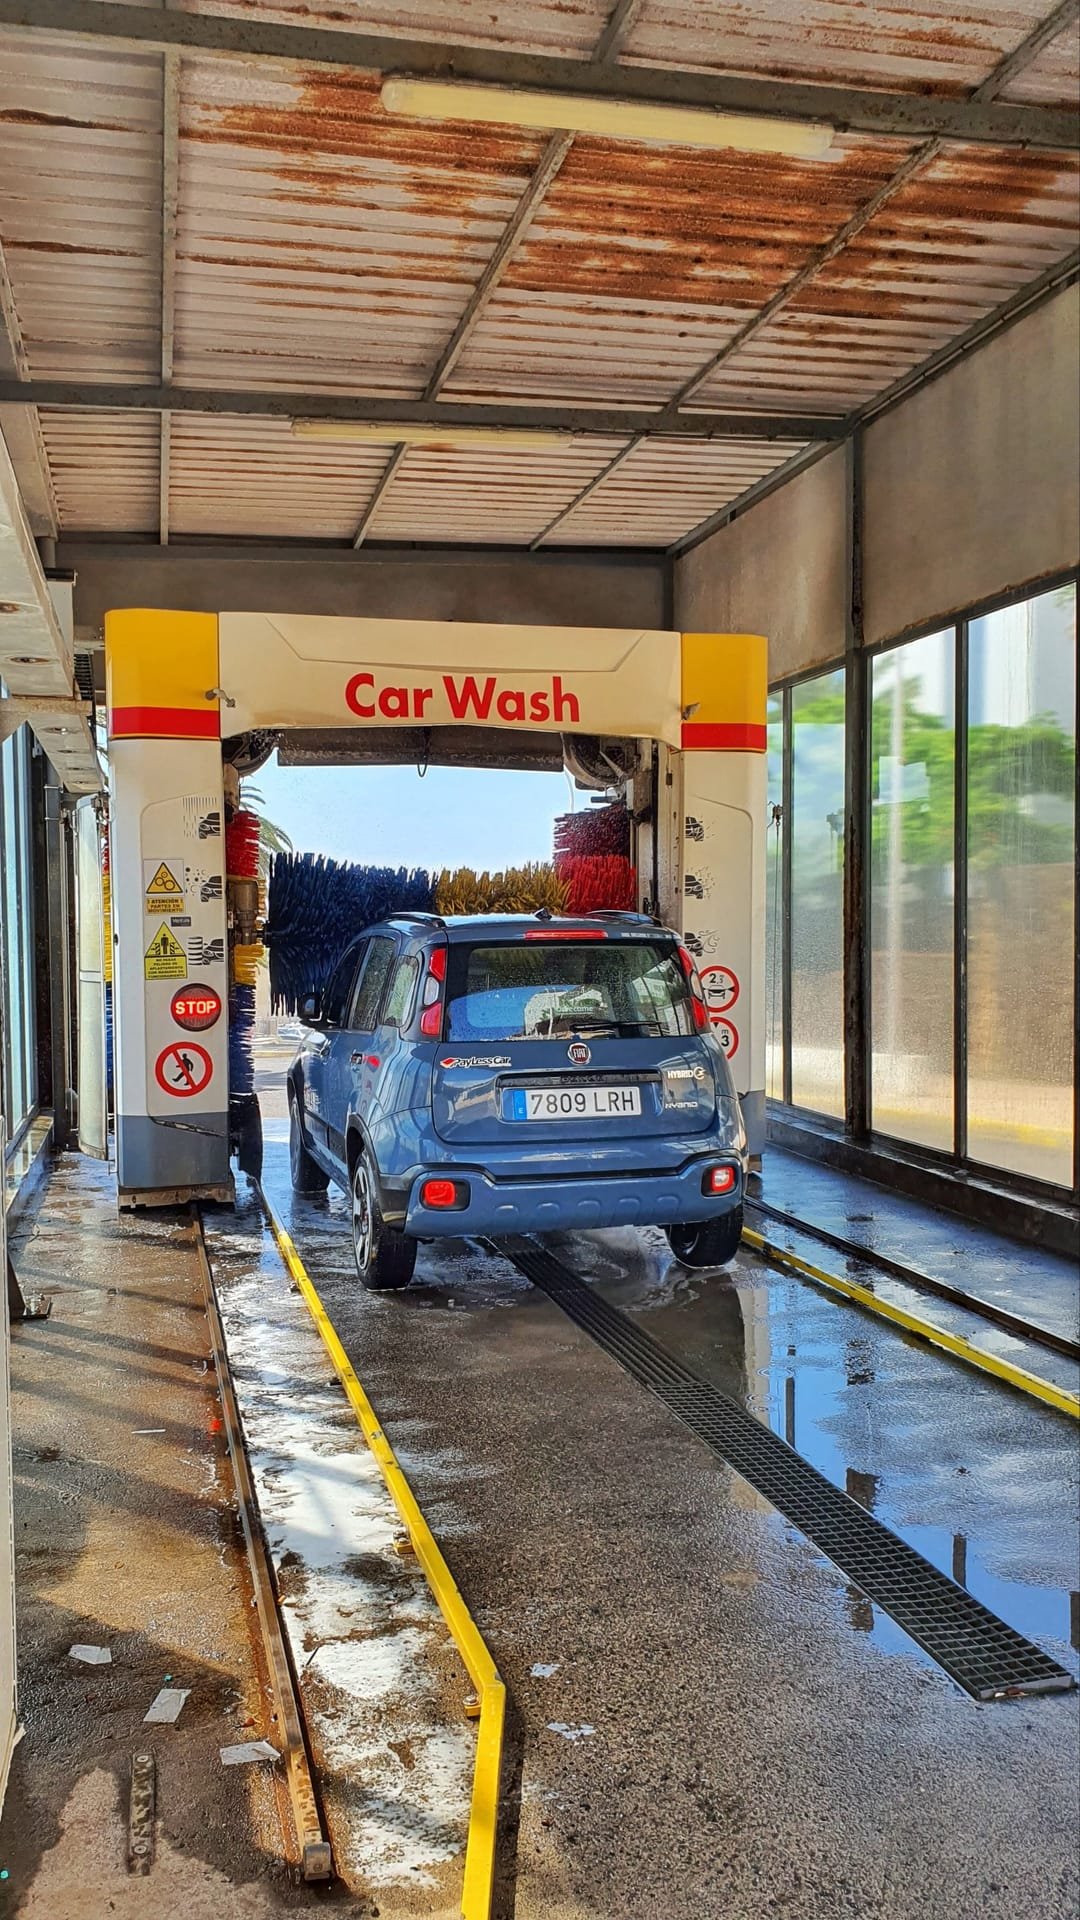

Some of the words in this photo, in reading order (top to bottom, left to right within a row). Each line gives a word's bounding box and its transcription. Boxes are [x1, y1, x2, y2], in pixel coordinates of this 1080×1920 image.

[345, 673, 433, 718] Car
[442, 676, 580, 722] Wash
[175, 1001, 216, 1014] STOP
[573, 1048, 586, 1058] FIAT
[667, 1070, 694, 1078] HYBRID
[531, 1093, 586, 1114] 7809
[594, 1091, 634, 1112] LRH
